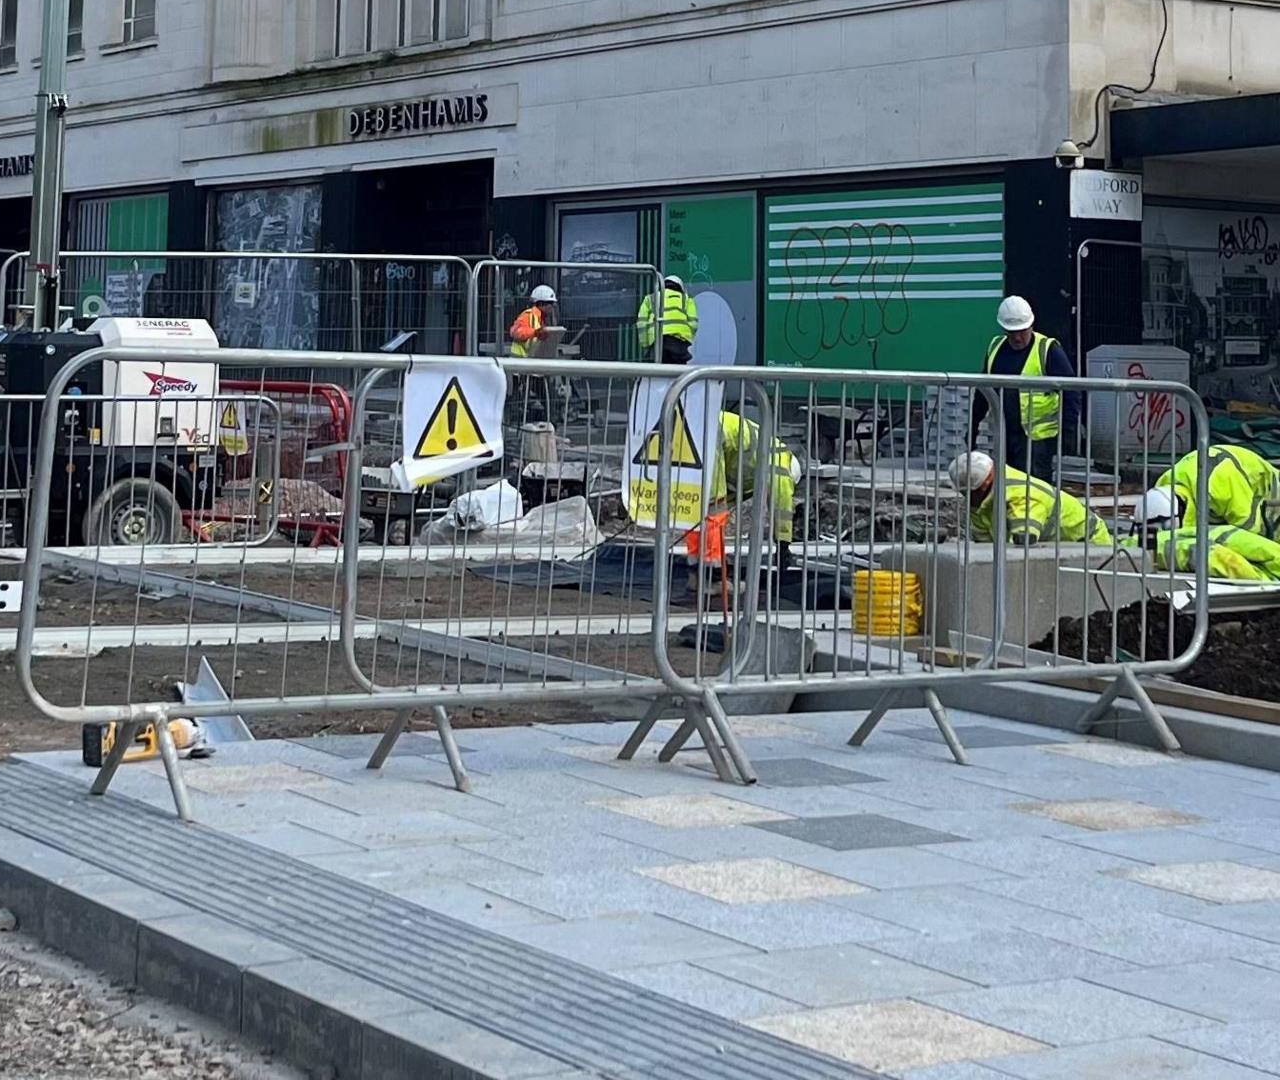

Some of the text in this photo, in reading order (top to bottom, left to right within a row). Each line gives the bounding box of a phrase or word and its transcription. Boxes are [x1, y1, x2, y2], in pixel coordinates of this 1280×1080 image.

[348, 93, 488, 137] DEBENHAMS
[1086, 177, 1139, 193] EDFORD
[1093, 199, 1122, 213] WAY
[156, 380, 197, 393] Speedy
